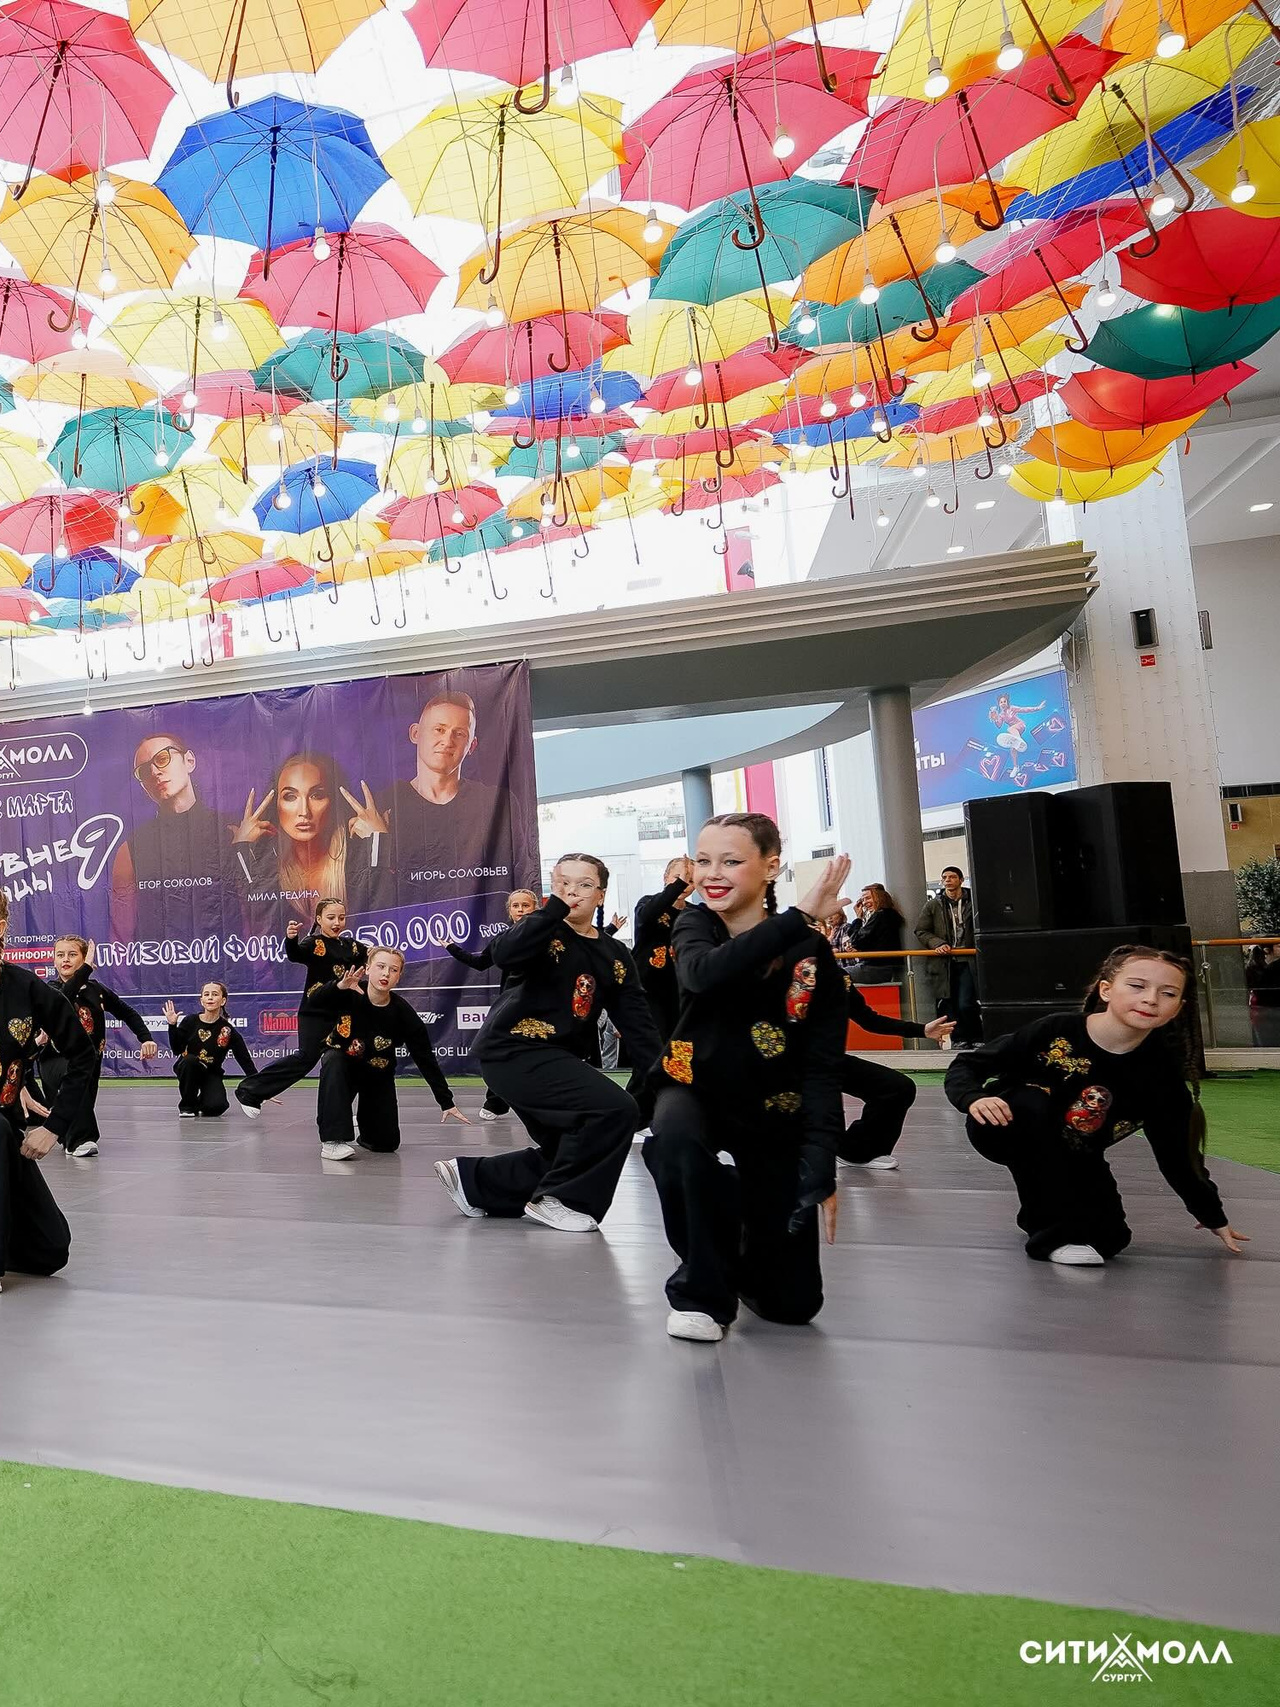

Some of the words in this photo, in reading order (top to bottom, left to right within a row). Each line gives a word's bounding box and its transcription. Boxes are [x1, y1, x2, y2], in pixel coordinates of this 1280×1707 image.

[6, 791, 73, 819] МАРТА
[138, 880, 161, 890] ЕГОР
[163, 877, 213, 888] СОКОЛОВ
[410, 870, 446, 881] ИГОРЬ
[448, 866, 508, 879] СОЛОВЬЕВ
[247, 891, 277, 902] МИЛА
[280, 889, 320, 900] РЕДИНА
[338, 910, 470, 951] 50.000
[96, 935, 220, 967] ПРИЗОВОЙ
